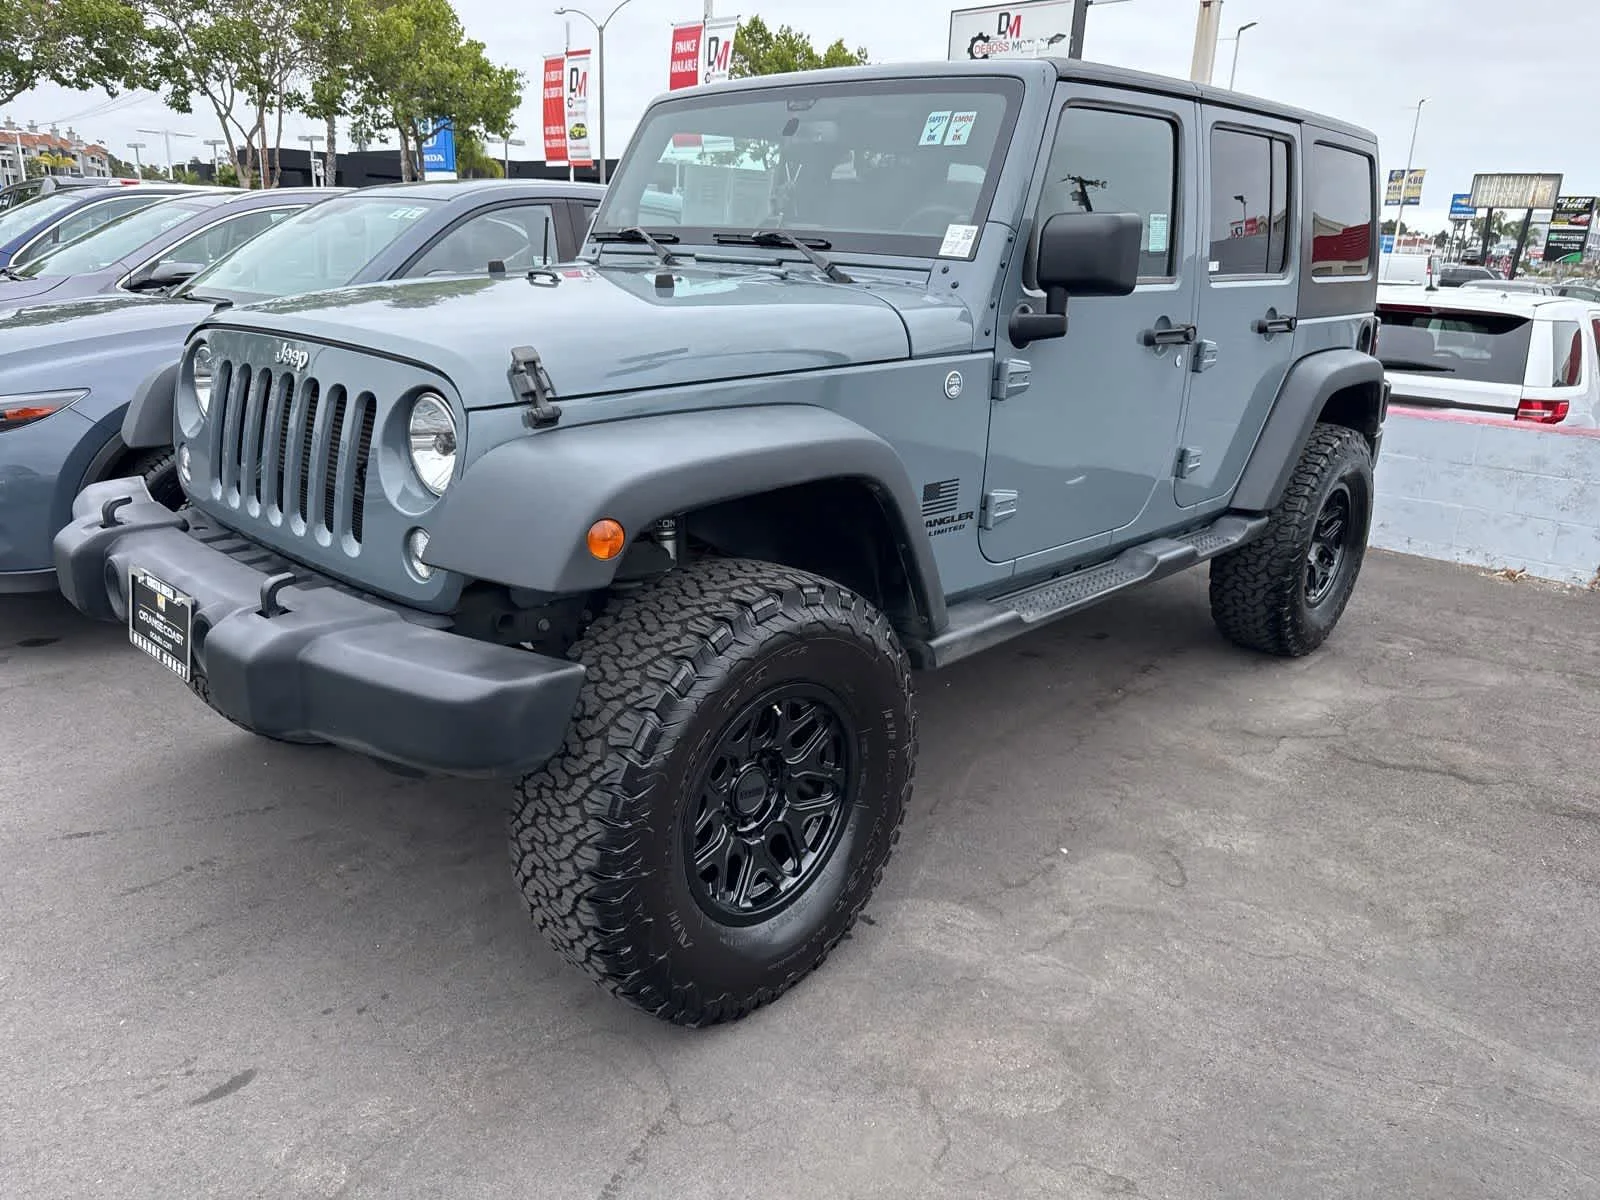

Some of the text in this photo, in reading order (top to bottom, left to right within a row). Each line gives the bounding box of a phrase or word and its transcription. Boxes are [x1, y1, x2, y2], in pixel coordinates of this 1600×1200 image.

[674, 39, 697, 54] FINANCE
[671, 59, 697, 73] AVAILABLE
[928, 115, 949, 123] SAFETY
[275, 342, 309, 372] Jeep
[928, 524, 966, 537] LIMITED
